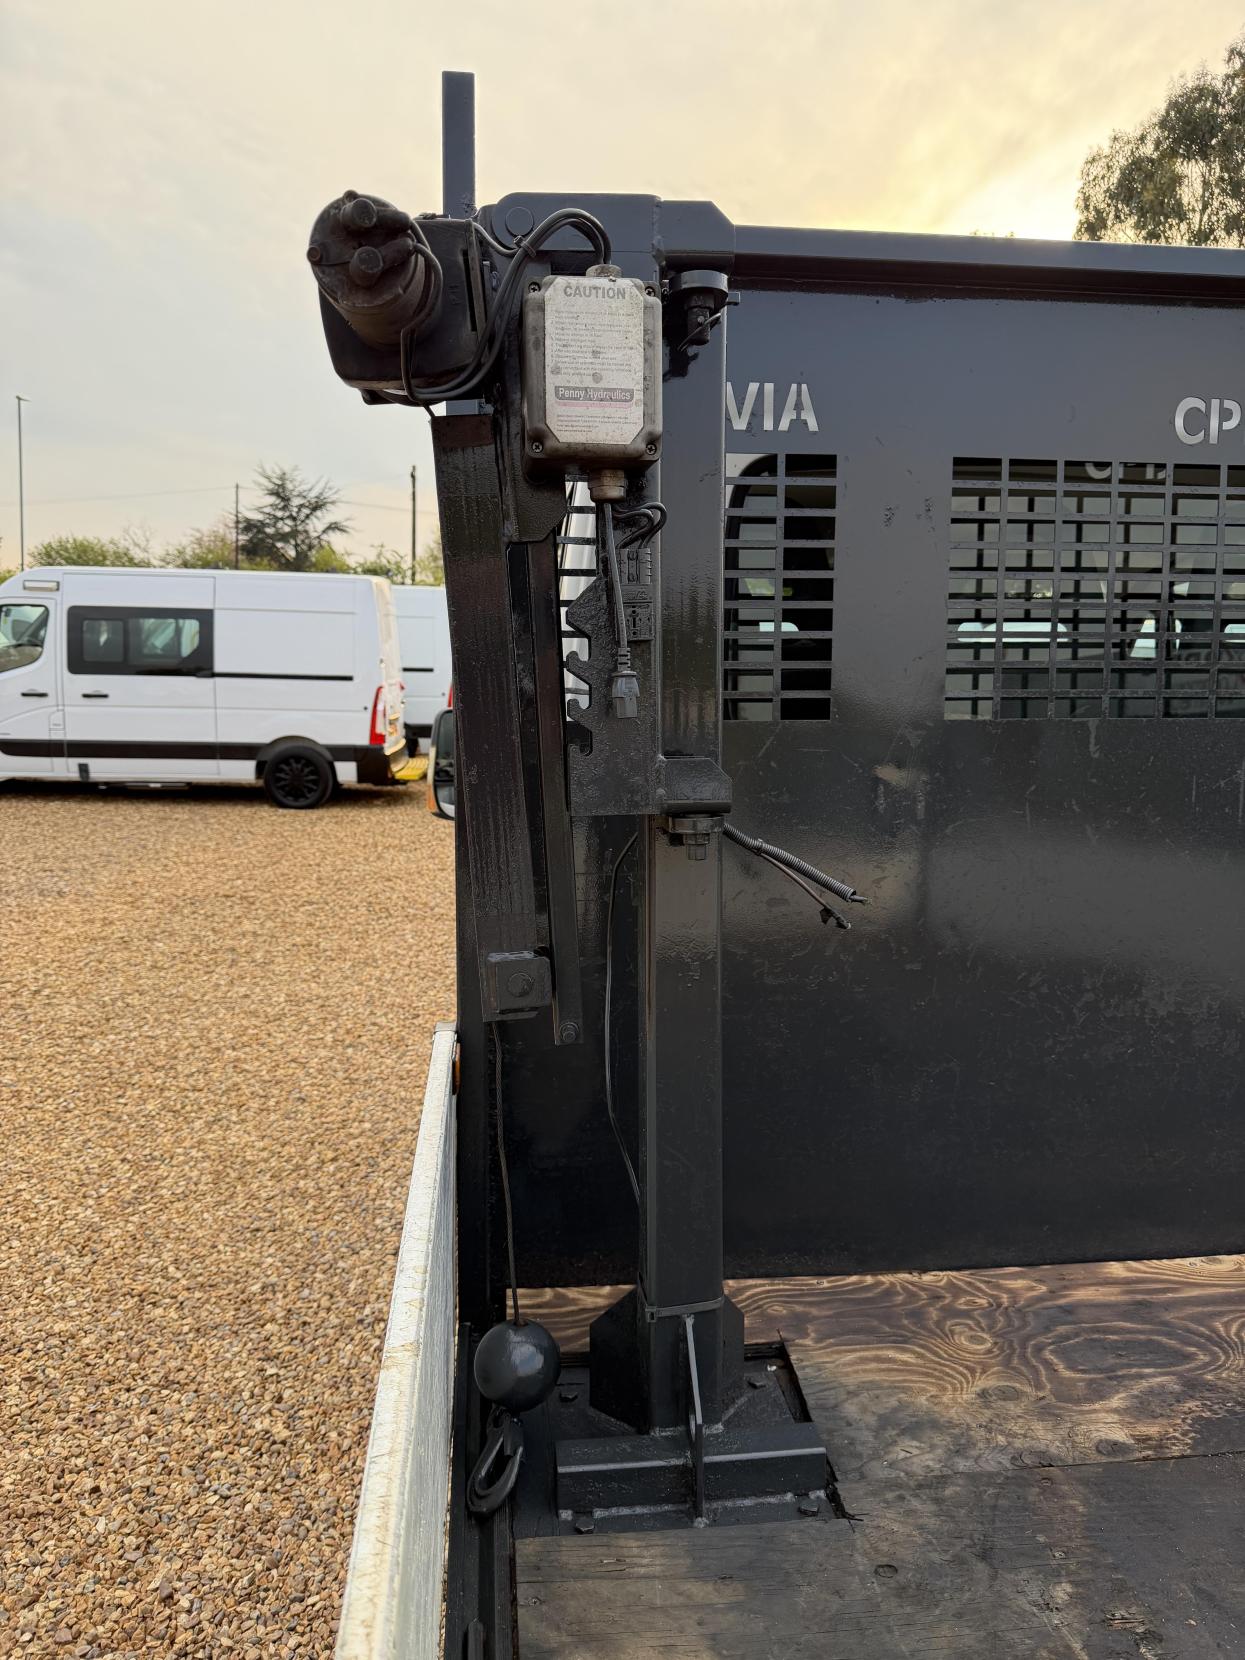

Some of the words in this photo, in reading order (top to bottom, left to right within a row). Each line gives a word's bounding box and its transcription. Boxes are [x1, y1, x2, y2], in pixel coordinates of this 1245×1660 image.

[564, 286, 626, 300] CAUTION
[559, 387, 585, 401] Penny
[587, 388, 631, 402] Hydraulics
